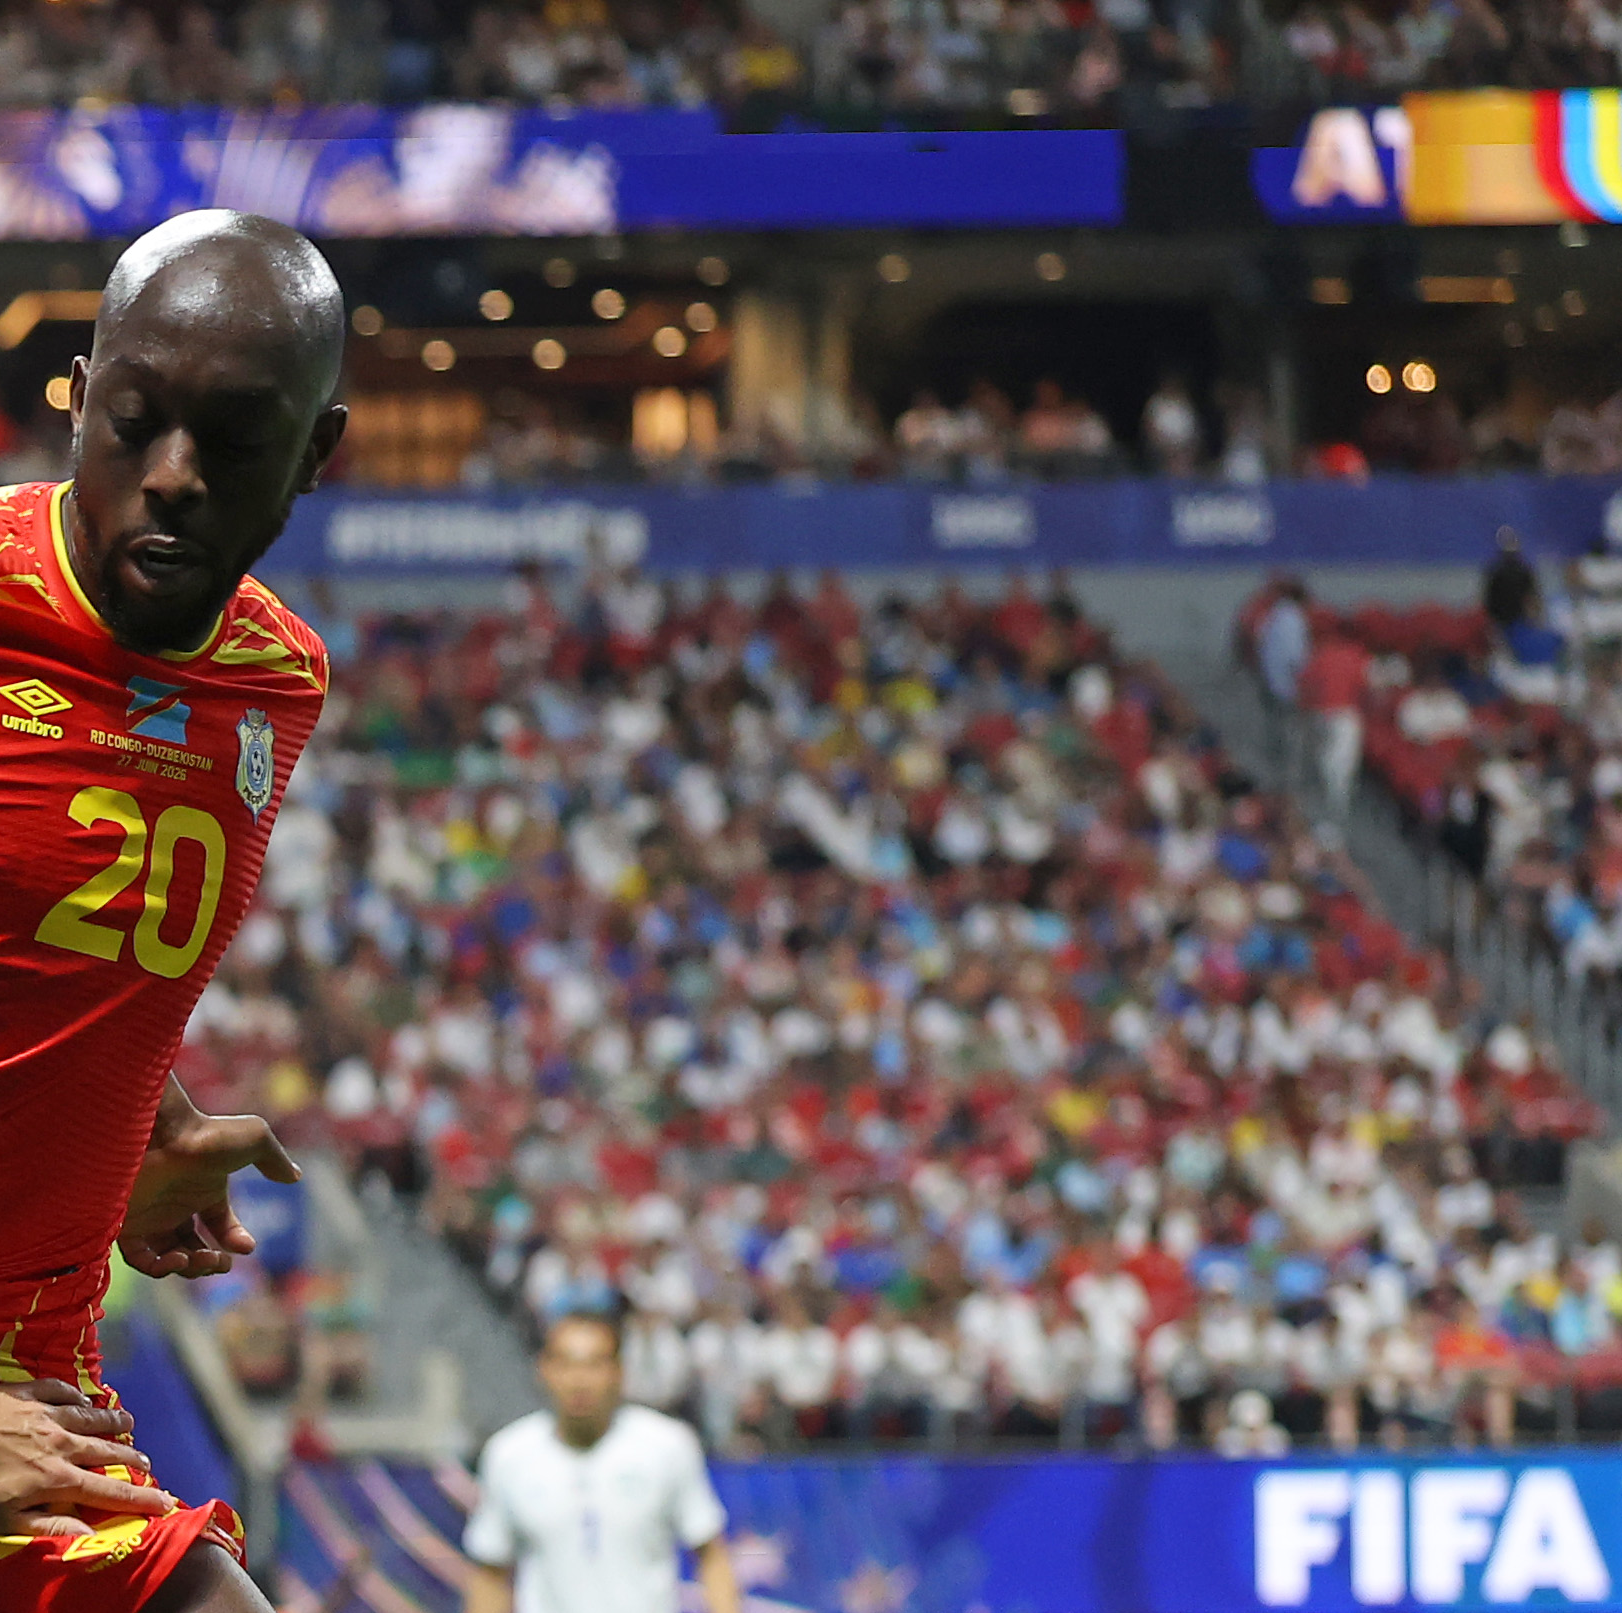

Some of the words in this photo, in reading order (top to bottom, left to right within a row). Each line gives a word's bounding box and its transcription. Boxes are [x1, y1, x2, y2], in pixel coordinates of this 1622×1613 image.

[2, 714, 64, 739] umbro
[90, 729, 106, 745] RD
[160, 764, 188, 781] 2026
[34, 786, 226, 979] 20
[1254, 1467, 1612, 1607] FIFA
